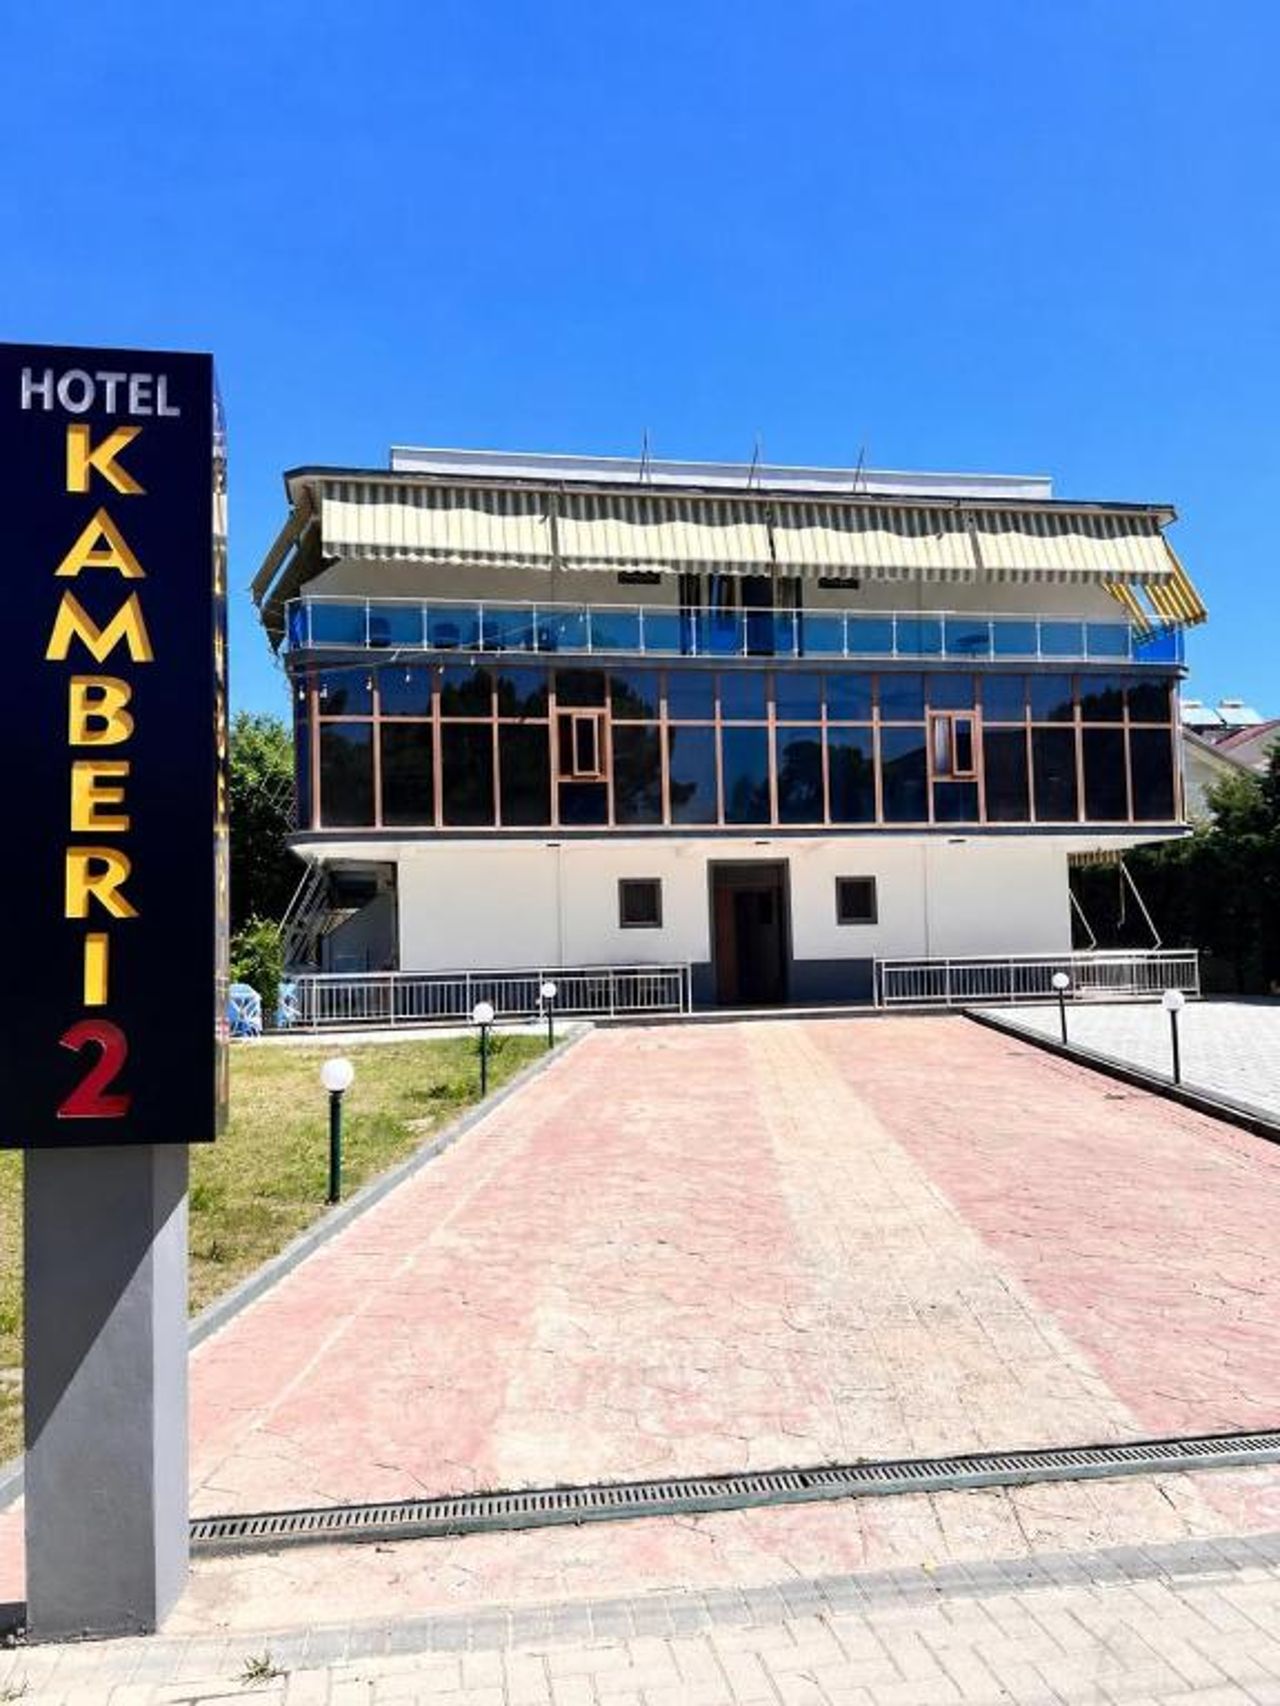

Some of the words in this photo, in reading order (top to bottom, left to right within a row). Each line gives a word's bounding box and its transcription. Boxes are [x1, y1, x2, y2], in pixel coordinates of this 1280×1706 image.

[20, 367, 181, 419] HOTEL
[45, 424, 154, 1008] KAMBERI
[56, 1018, 131, 1120] 2
